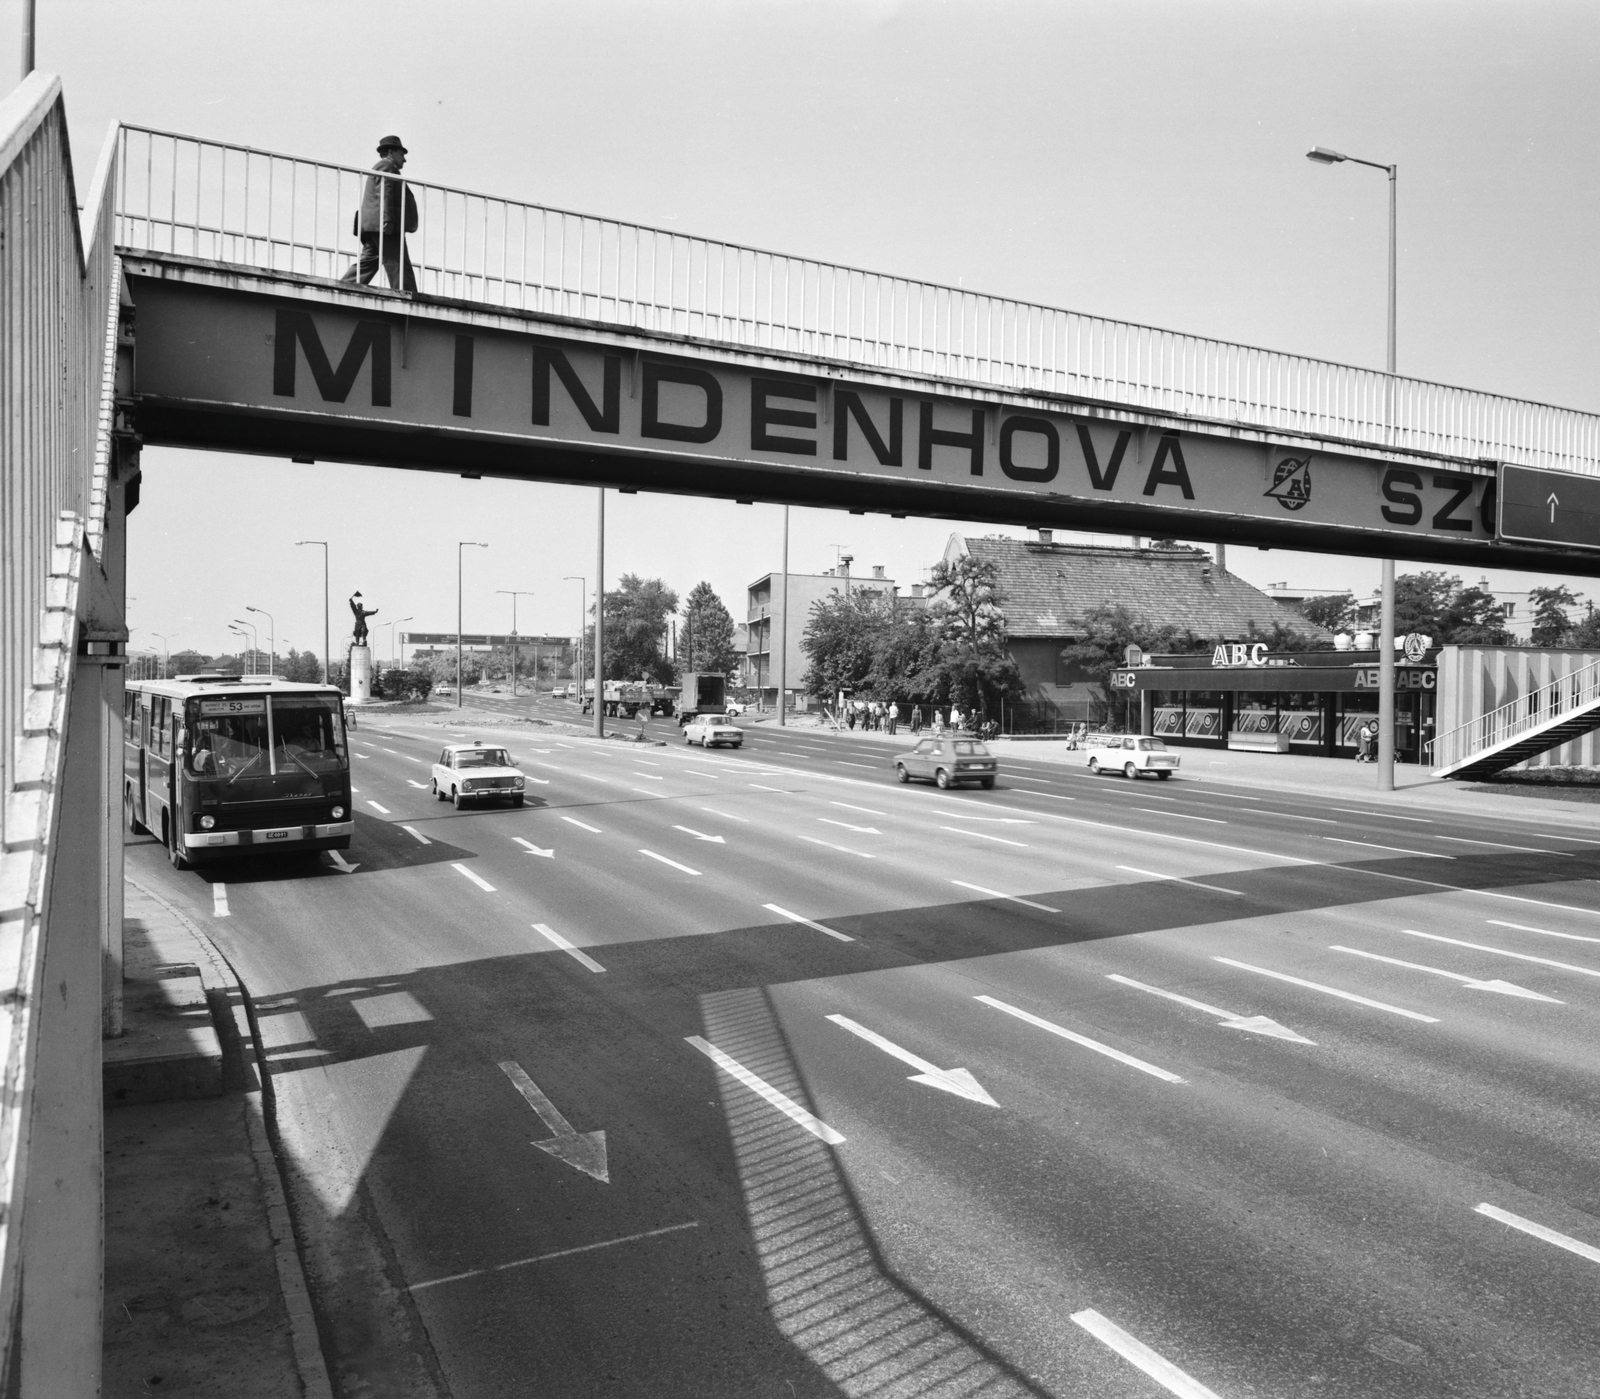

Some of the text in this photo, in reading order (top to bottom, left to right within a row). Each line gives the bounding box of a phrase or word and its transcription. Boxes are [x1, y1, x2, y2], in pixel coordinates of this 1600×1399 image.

[273, 308, 1195, 500] MINDENHOVÁ
[1211, 643, 1268, 665] ABC
[1110, 672, 1136, 687] ABC
[1354, 670, 1395, 688] AB
[1397, 671, 1435, 689] ABC
[229, 702, 243, 711] 53
